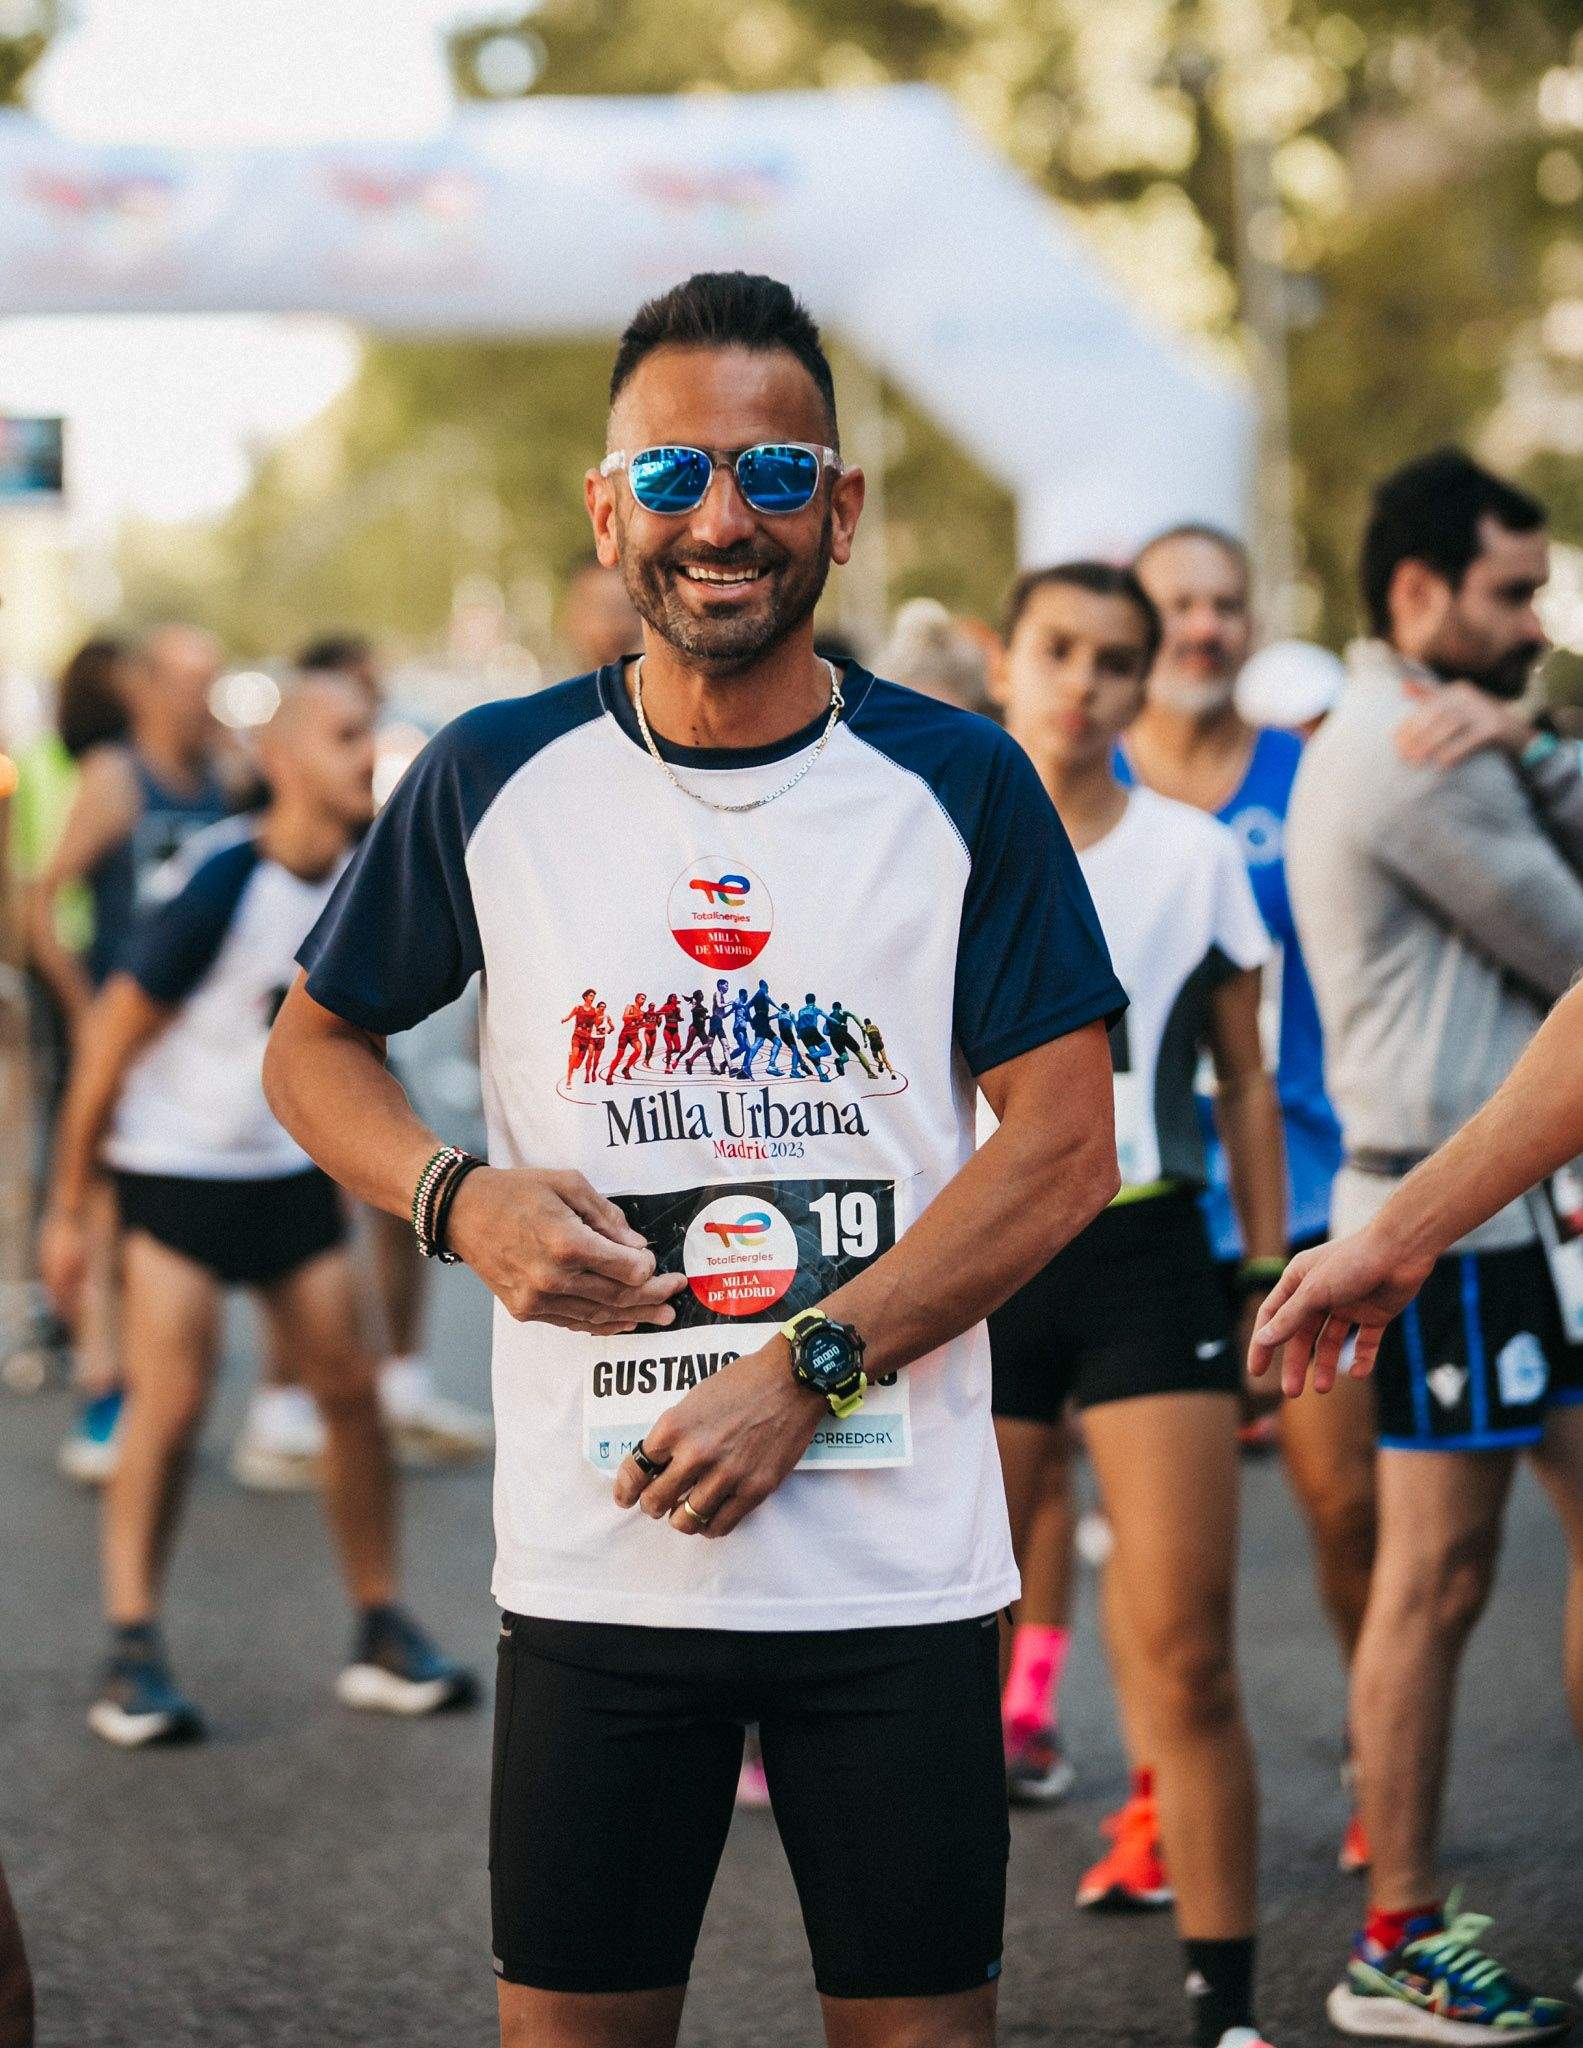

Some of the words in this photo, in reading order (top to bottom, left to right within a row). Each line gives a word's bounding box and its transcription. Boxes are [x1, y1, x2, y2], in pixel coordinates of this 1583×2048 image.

[695, 944, 710, 955] DE
[713, 944, 752, 956] MADRID
[602, 1088, 713, 1148] Milla
[716, 1086, 870, 1140] Urbana
[769, 1142, 805, 1159] 2023
[808, 1191, 879, 1258] 19
[706, 1252, 774, 1266] TotalEnergies
[721, 1274, 760, 1288] MILLA
[708, 1290, 725, 1303] DE
[727, 1286, 776, 1300] MADRID
